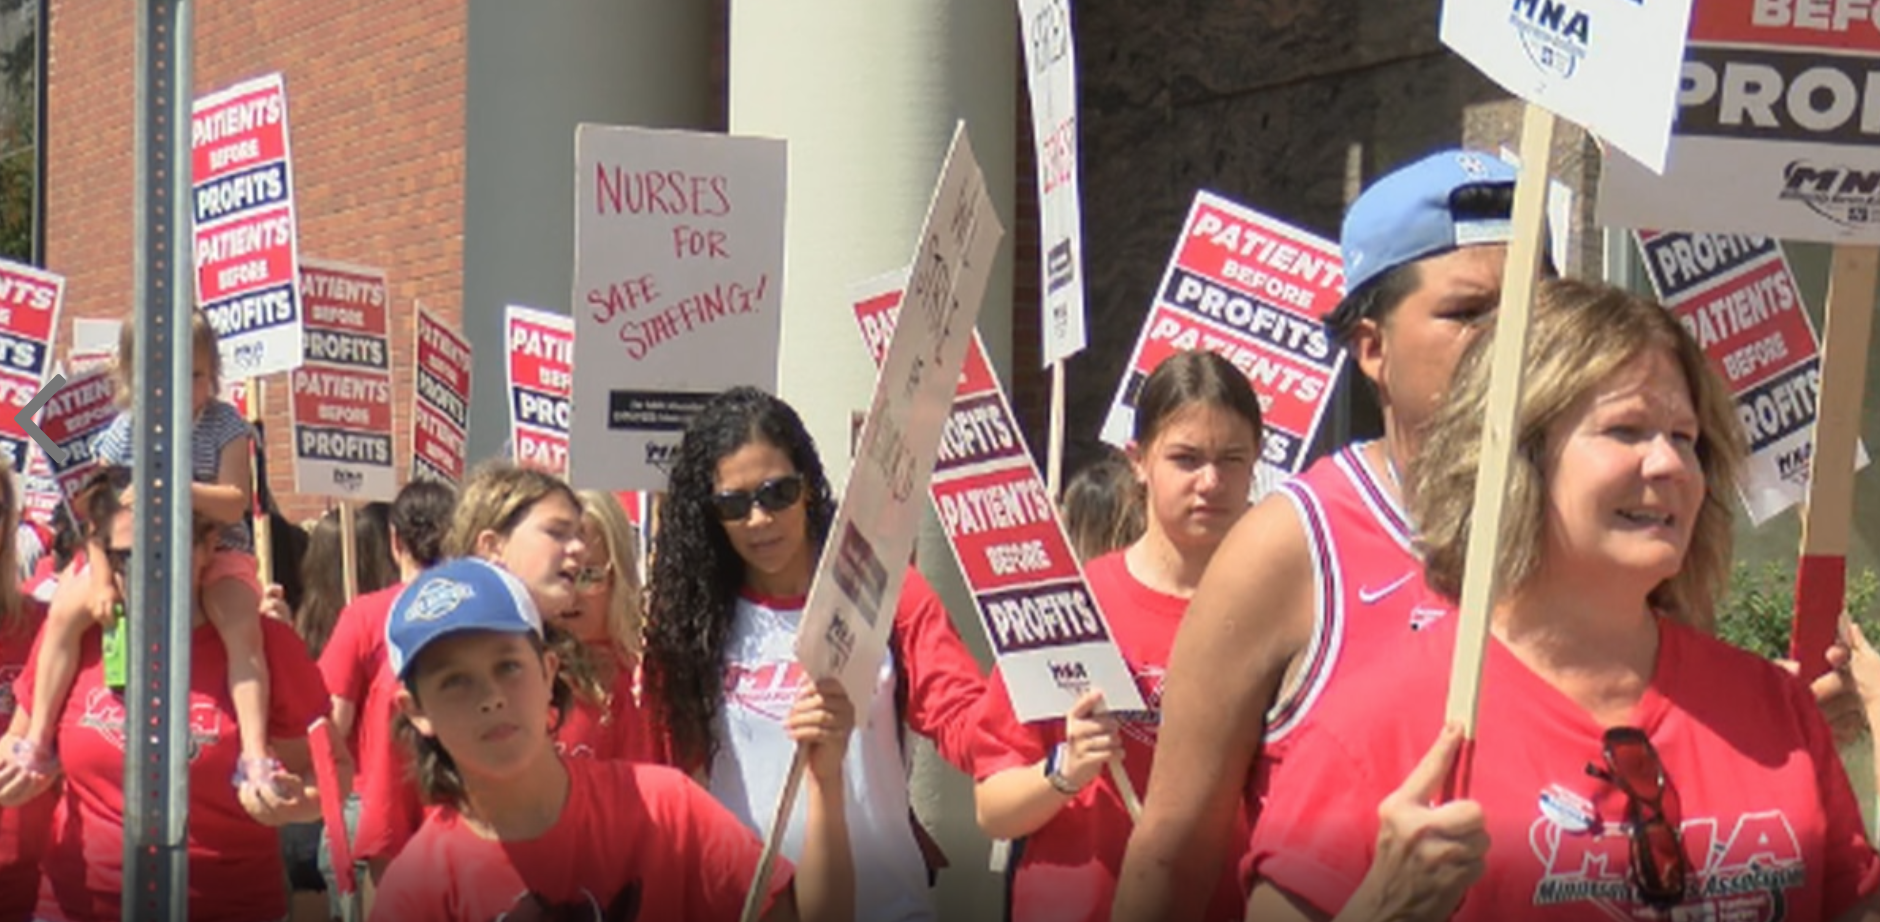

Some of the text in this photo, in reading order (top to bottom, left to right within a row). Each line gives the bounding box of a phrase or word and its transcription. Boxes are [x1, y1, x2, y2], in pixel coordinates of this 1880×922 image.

[1512, 0, 1589, 45] MNA
[1751, 0, 1880, 32] BEF
[192, 93, 281, 148] PATIENTS
[208, 138, 260, 171] BEFORE
[1785, 166, 1880, 194] MN
[198, 166, 284, 219] PROFITS
[596, 161, 731, 218] NURSES
[198, 216, 290, 266] PATIENTS
[673, 225, 730, 259] FOR
[1192, 212, 1348, 297] PATIENT
[1655, 232, 1766, 288] PROFI
[217, 260, 269, 291] BEFORE
[300, 273, 384, 307] ATIENTS
[587, 273, 661, 325] SAFE
[1220, 259, 1315, 310] BEFORE
[209, 289, 292, 337] PROFITS
[619, 274, 768, 362] STAFFING!
[1175, 276, 1329, 360] PROFITS
[1682, 270, 1794, 350] PATIENTS
[1722, 332, 1789, 381] BEFORE
[295, 369, 389, 404] PATIENTS
[1738, 369, 1821, 445] ROFITS
[302, 429, 388, 463] PROFITS
[938, 404, 1014, 462] OFITS
[940, 479, 1050, 537] PATIENTS
[985, 539, 1053, 576] BEFORE
[986, 590, 1099, 647] PROFITS
